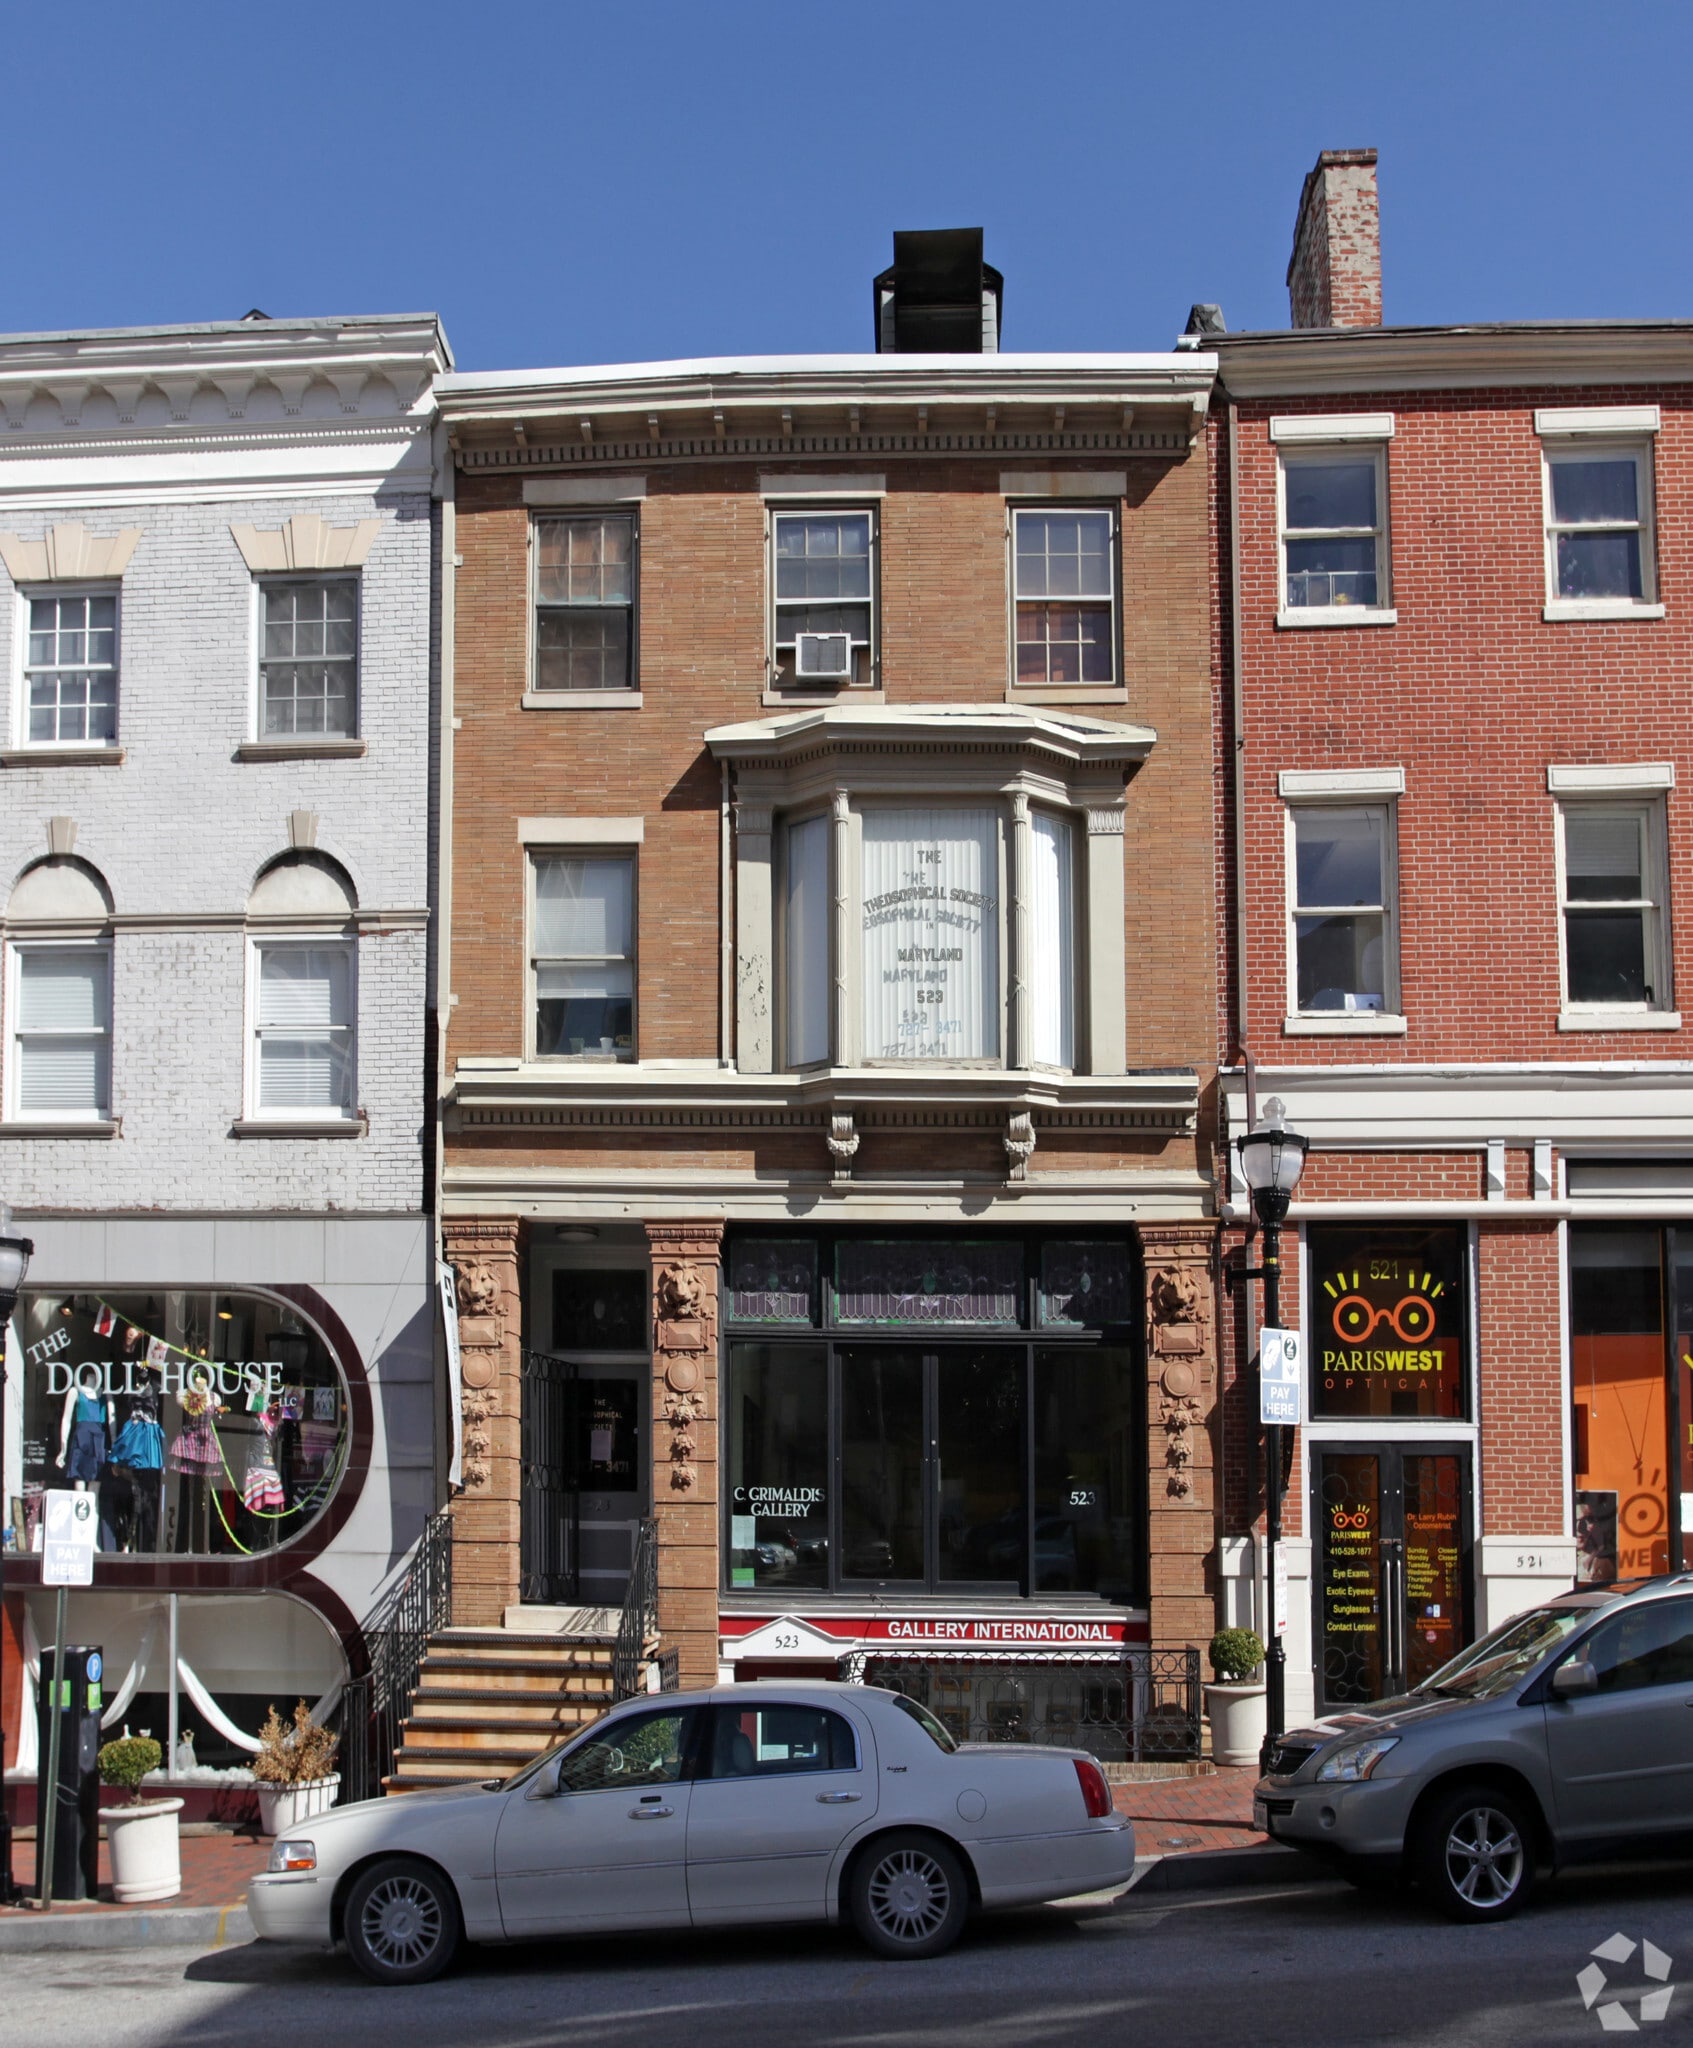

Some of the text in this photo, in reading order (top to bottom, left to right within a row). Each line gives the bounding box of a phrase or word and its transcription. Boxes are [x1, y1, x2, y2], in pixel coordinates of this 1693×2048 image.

[917, 850, 941, 864] THE
[862, 886, 997, 913] THEOSOPHICAL SOCIETY
[897, 948, 962, 961] MARYLAND
[917, 990, 943, 1003] 523
[1370, 1260, 1398, 1280] 521
[27, 1327, 72, 1365] THE
[1286, 1338, 1294, 1352] 2
[1323, 1350, 1445, 1371] PARISWEST
[46, 1362, 285, 1395] DOLL HOUSE
[1270, 1386, 1290, 1399] PAY
[278, 1397, 298, 1408] LLC
[1266, 1402, 1295, 1416] HERE
[748, 1487, 826, 1502] GRIMALDIS
[1069, 1491, 1096, 1505] 523
[78, 1498, 87, 1513] 2
[750, 1502, 811, 1517] GALLERY
[1330, 1531, 1371, 1539] PARISWEST
[56, 1547, 80, 1560] PAY
[1407, 1547, 1428, 1555] Sunday
[1517, 1555, 1542, 1568] 521
[51, 1563, 86, 1576] HERE
[1333, 1569, 1369, 1579] Eye Exams
[1407, 1569, 1440, 1577] Wednesday
[1407, 1576, 1434, 1584] Thursday
[1327, 1587, 1375, 1597] Exotic Eyewear
[1407, 1583, 1425, 1591] Friday
[1333, 1604, 1370, 1615] Sunglasses
[887, 1621, 1114, 1640] GALLERY INTERNATIONAL
[1327, 1622, 1352, 1632] Contact
[775, 1635, 799, 1649] 523
